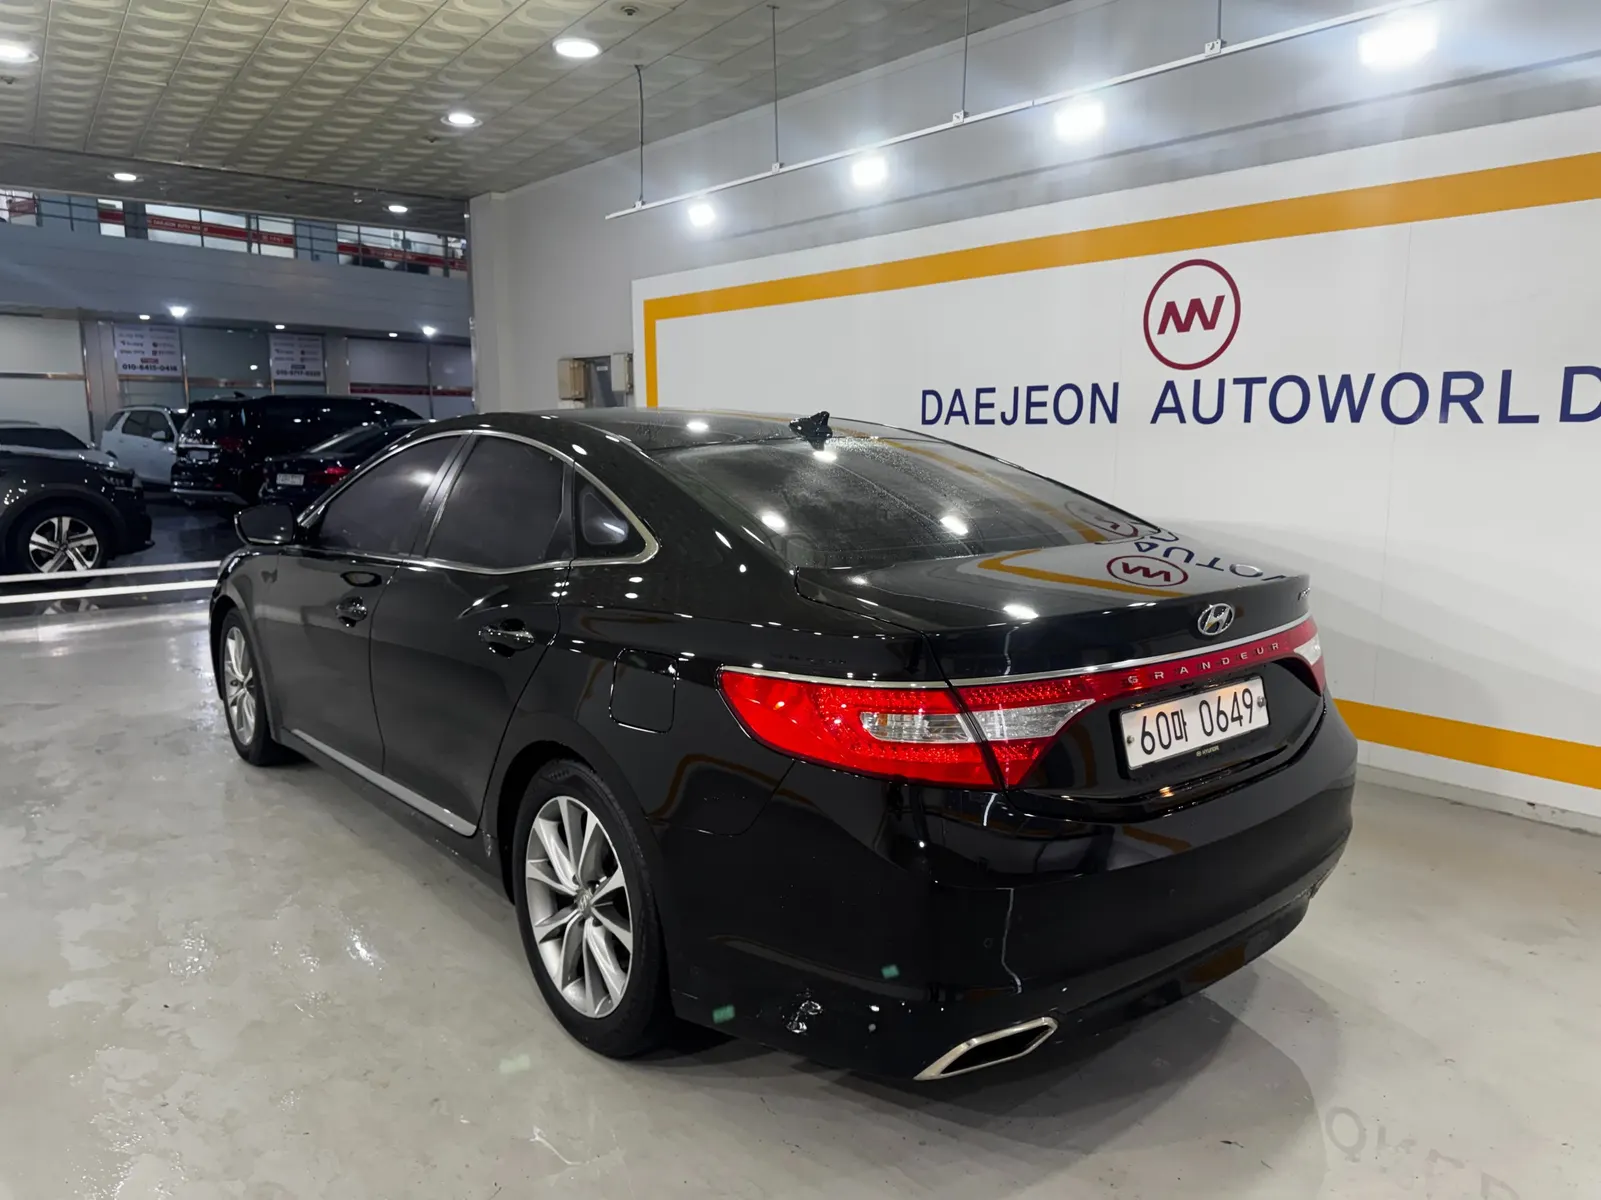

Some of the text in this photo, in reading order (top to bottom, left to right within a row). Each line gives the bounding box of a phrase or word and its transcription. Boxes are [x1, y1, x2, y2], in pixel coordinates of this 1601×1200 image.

[920, 365, 1601, 426] DAEJEON AUTOWORLD
[1127, 642, 1279, 684] GRANDEUR
[1141, 688, 1253, 755] 60마 0649
